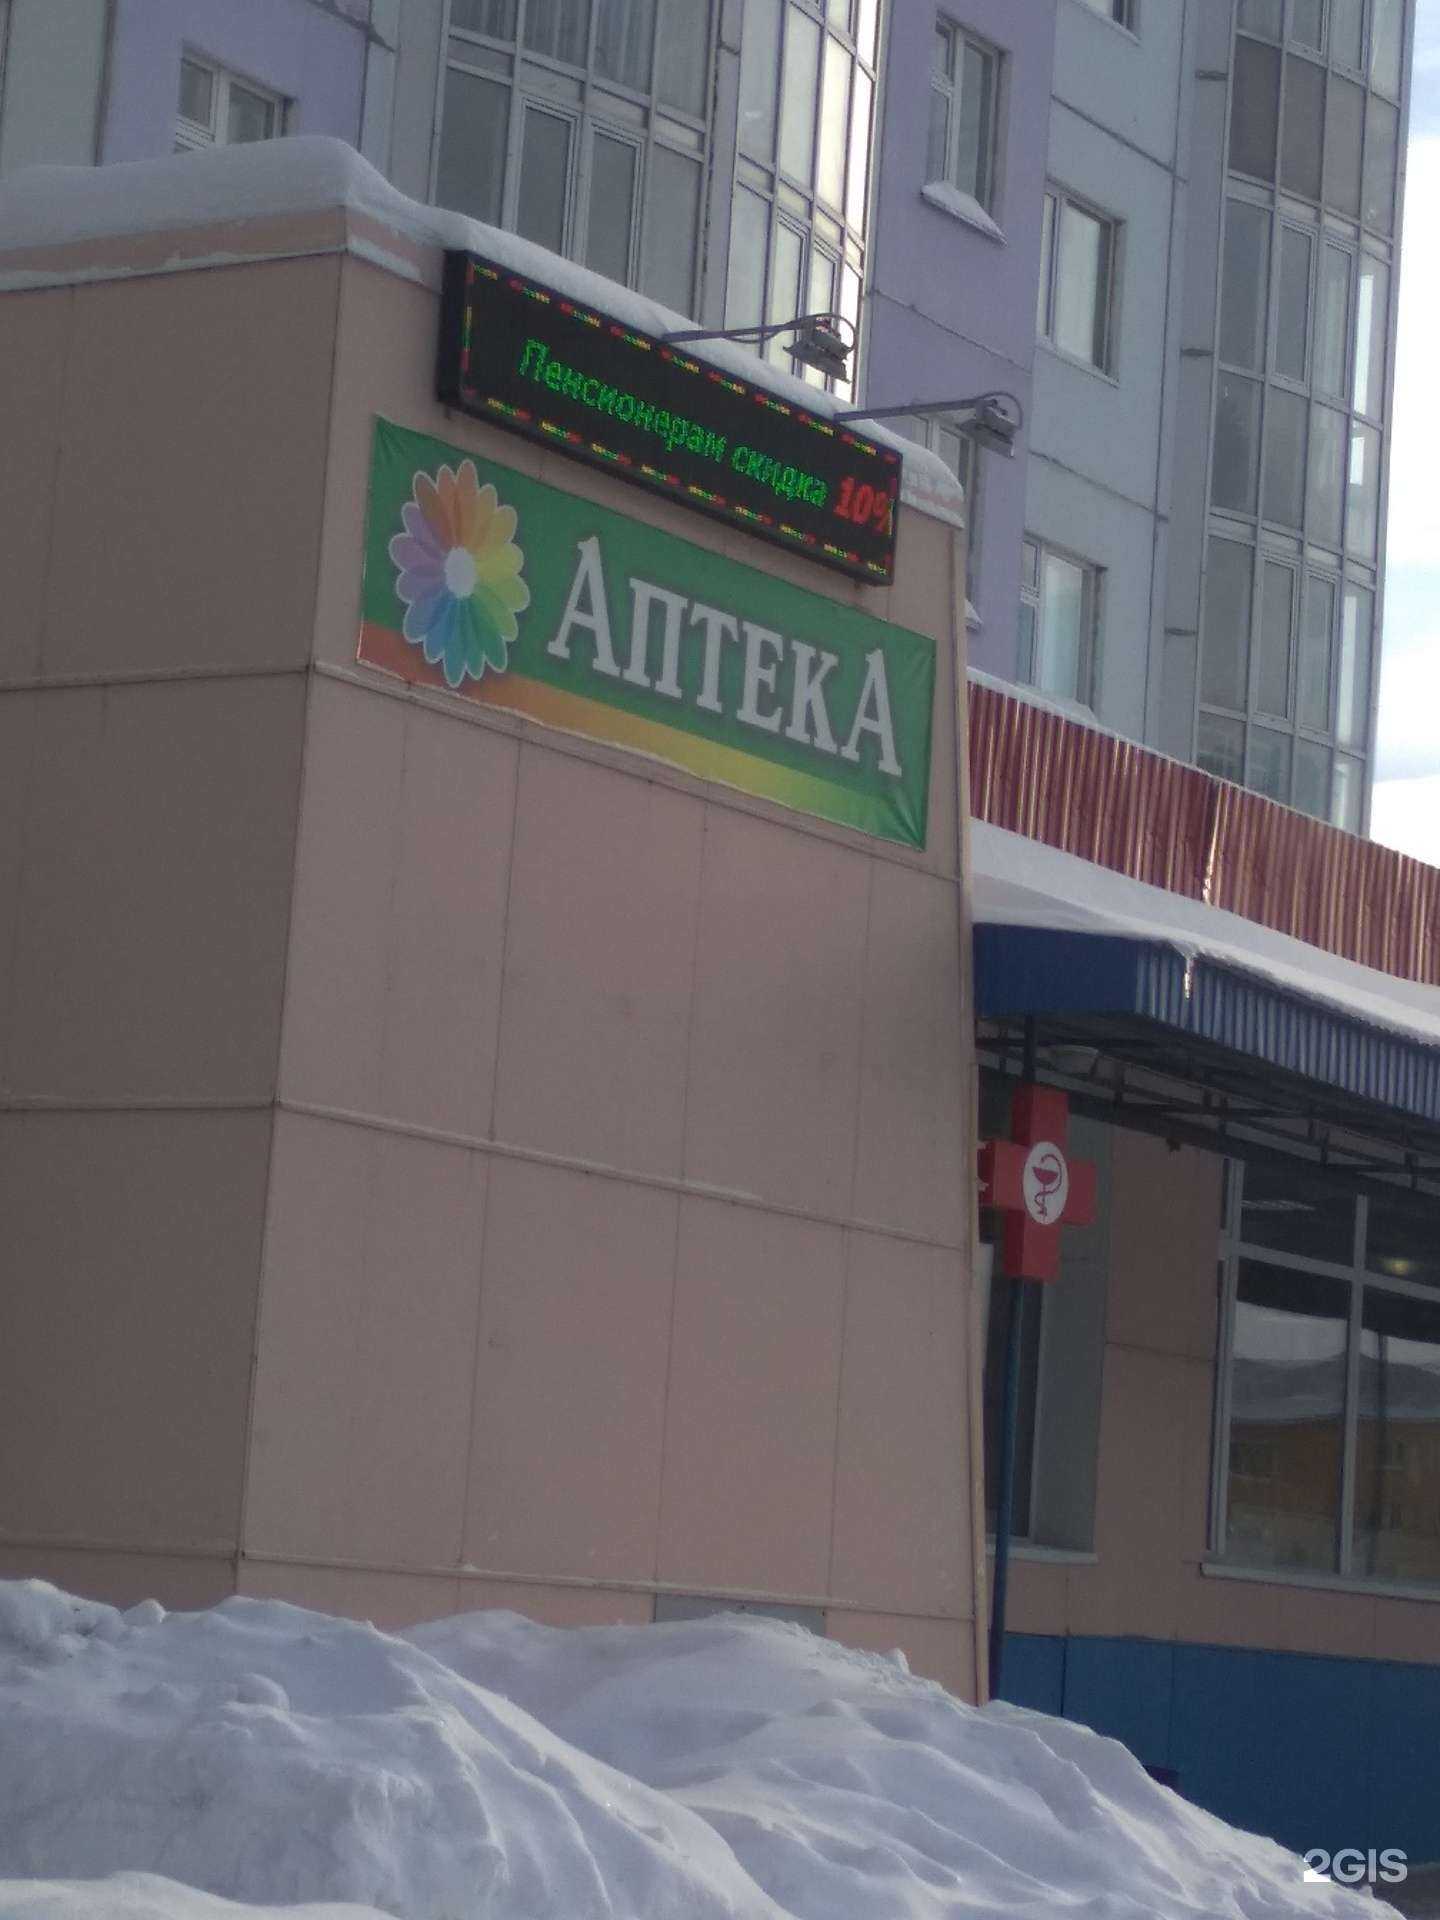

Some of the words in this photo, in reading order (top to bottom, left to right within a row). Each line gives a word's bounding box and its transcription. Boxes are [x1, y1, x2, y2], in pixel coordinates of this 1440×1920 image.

[519, 338, 727, 464] Пенсионерам
[731, 446, 828, 509] скидка
[547, 535, 902, 777] АПТЕКА
